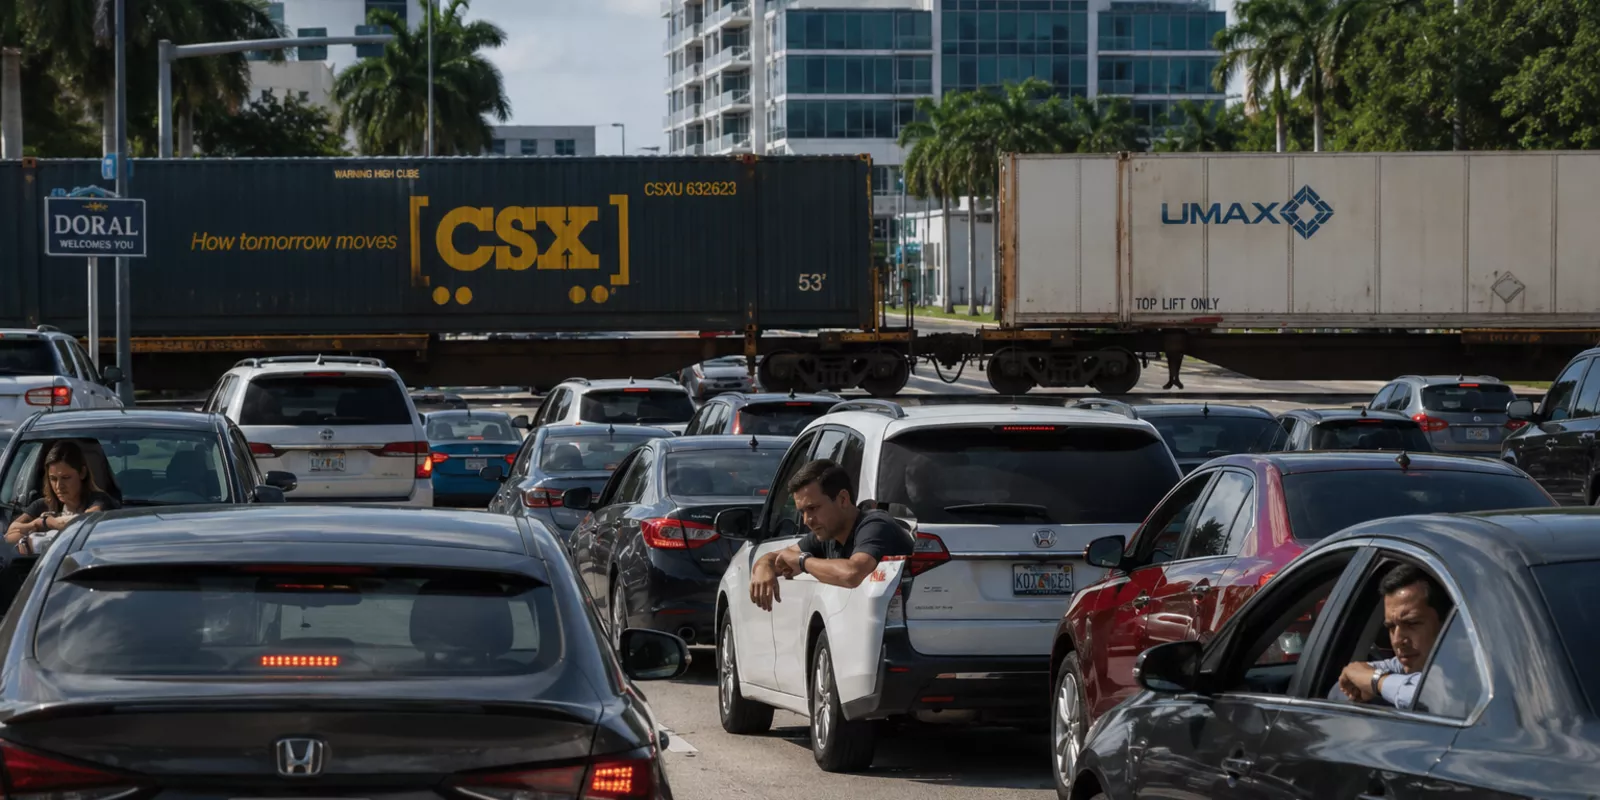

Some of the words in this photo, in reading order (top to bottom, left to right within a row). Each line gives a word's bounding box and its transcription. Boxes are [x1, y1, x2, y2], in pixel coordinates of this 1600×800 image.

[334, 169, 372, 179] WARNING
[374, 169, 395, 178] HIGH
[396, 168, 420, 178] CUBE
[644, 181, 683, 196] CSXU
[686, 181, 737, 196] 632623
[1161, 202, 1281, 225] UMAX
[54, 214, 139, 236] DORAL
[59, 239, 112, 249] WELCOMES
[114, 240, 134, 250] YOU
[191, 231, 235, 250] How
[240, 232, 331, 250] tomorrow
[335, 234, 398, 250] moves
[435, 205, 600, 271] CSX
[1135, 297, 1158, 310] TOP
[1162, 297, 1186, 310] LIFT
[1191, 297, 1220, 310] ONLY
